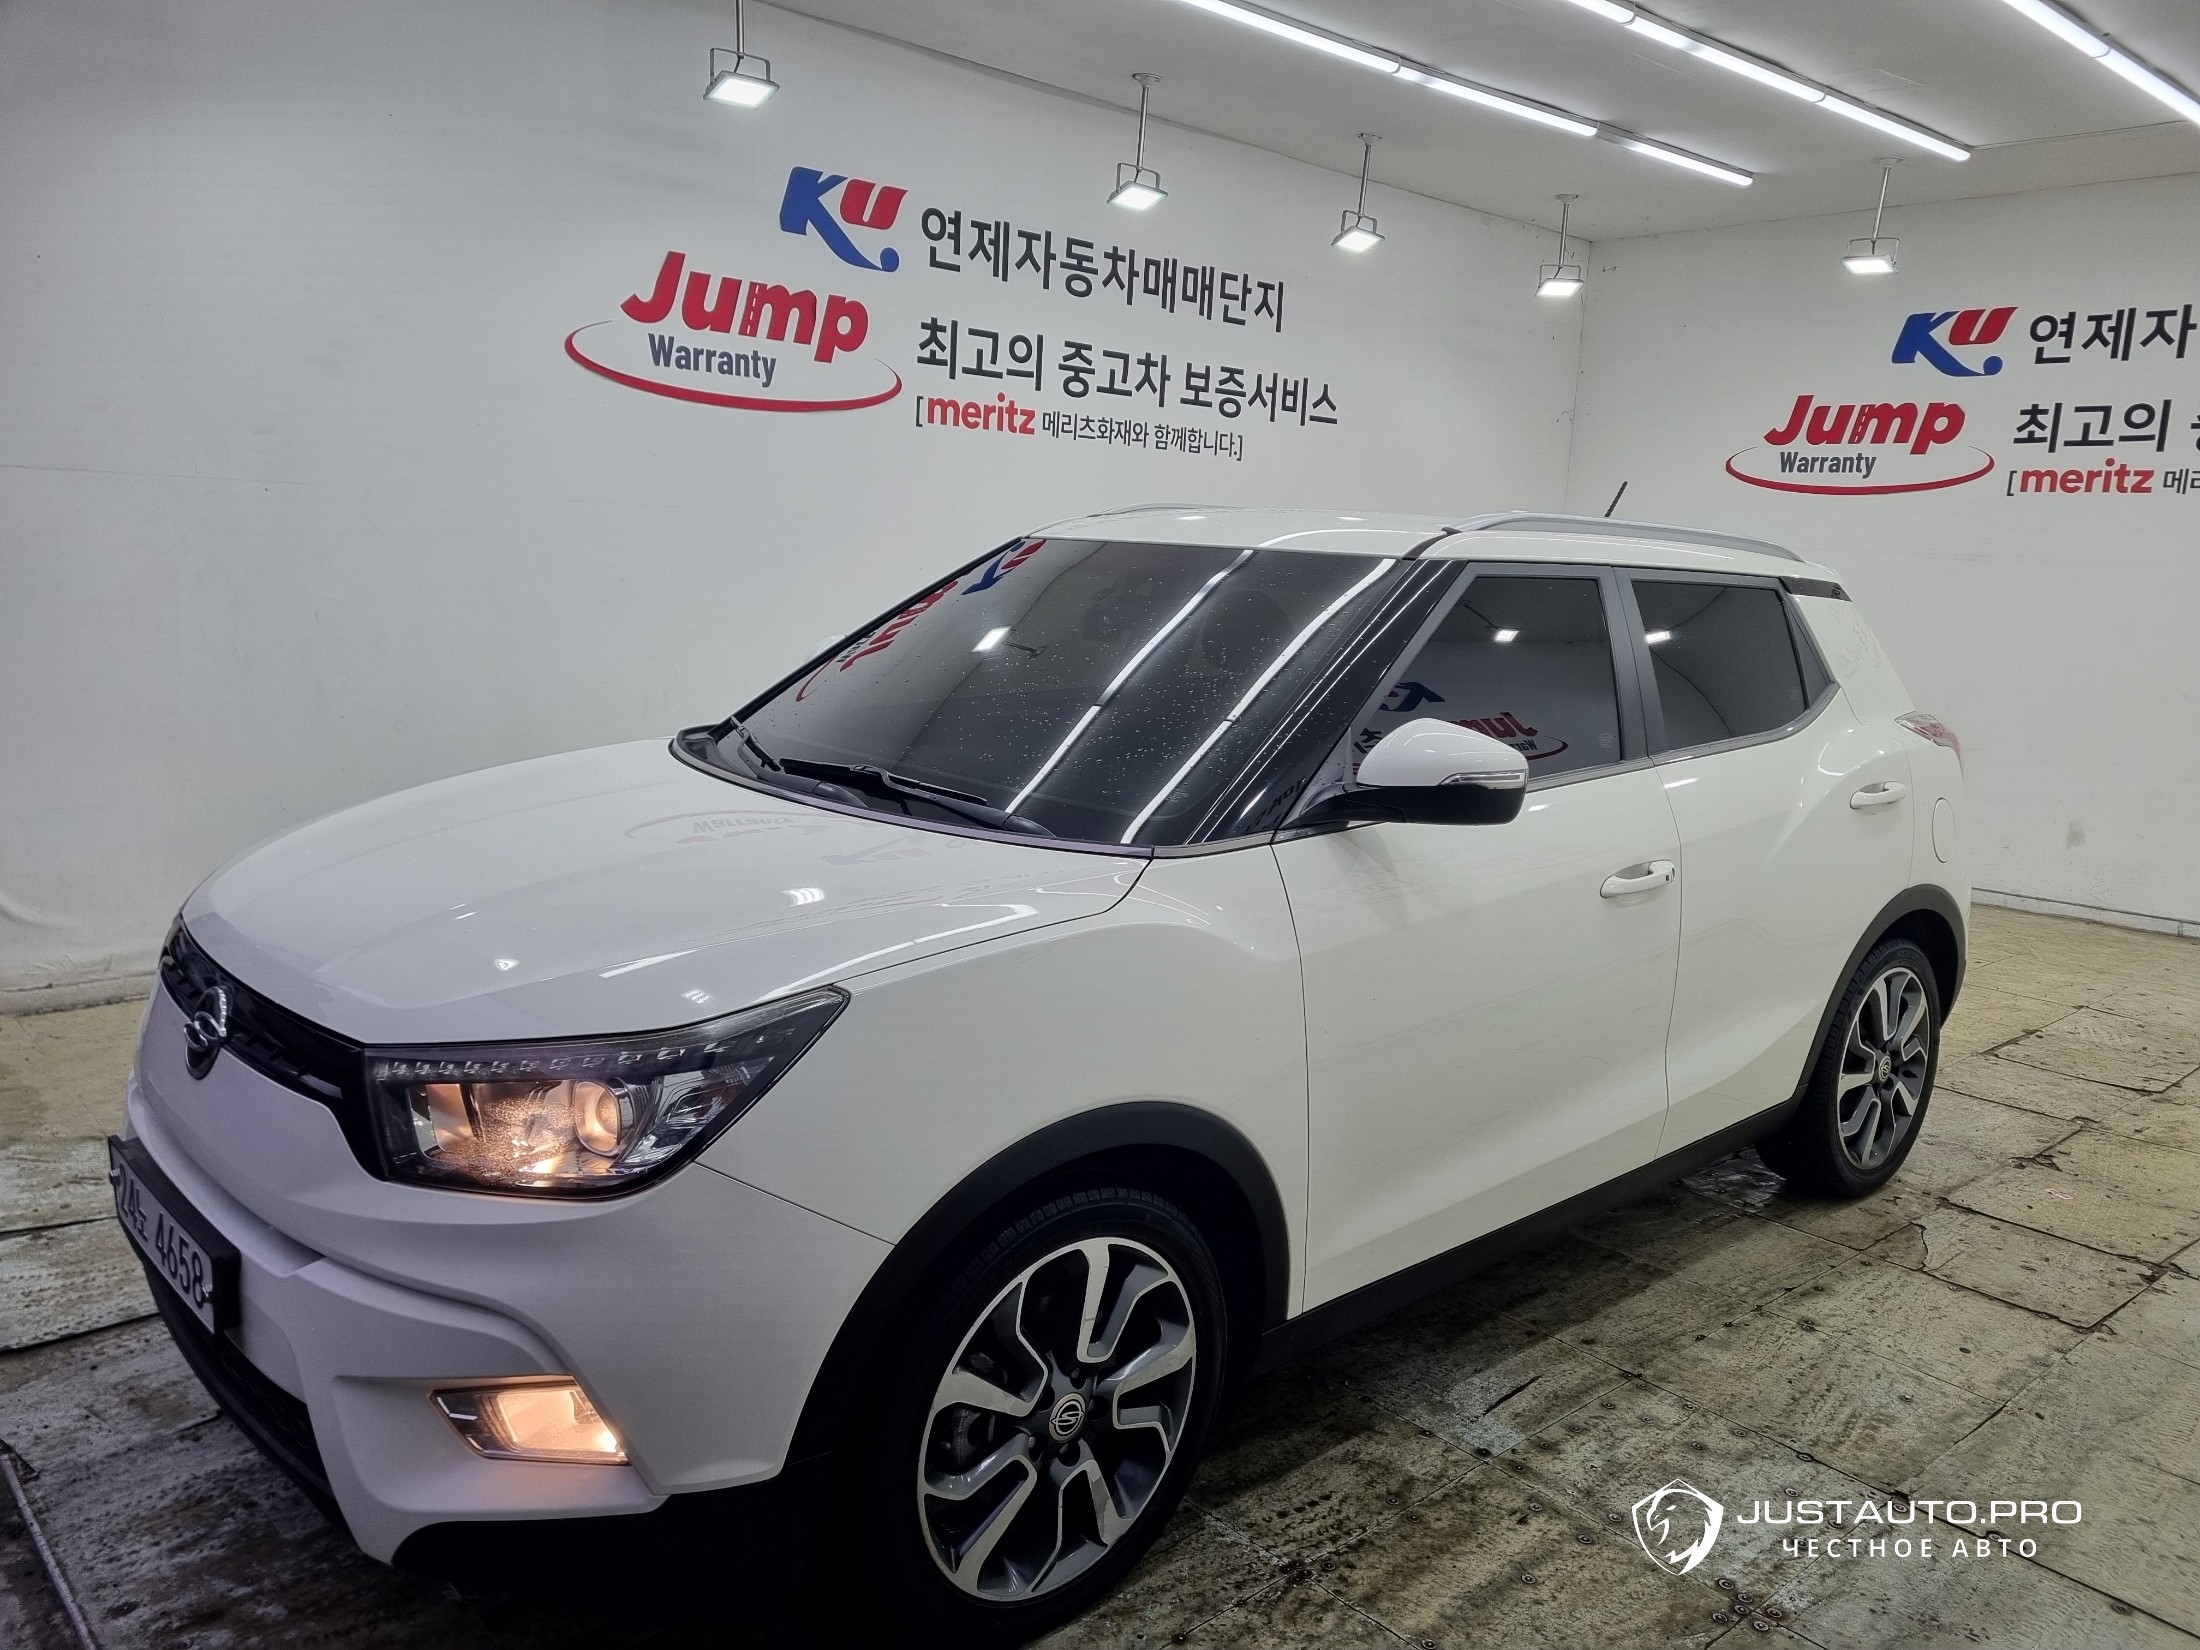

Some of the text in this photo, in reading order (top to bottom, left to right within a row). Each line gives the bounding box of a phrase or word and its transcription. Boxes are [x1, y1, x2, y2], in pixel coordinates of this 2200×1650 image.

[921, 207, 1285, 332] 연제자동차매매단지
[620, 251, 868, 363] Jump
[2029, 304, 2198, 364] 연제자
[648, 332, 776, 387] Warranty
[917, 317, 1338, 426] 최고의 중고차 보증서비스
[1042, 410, 1149, 449] 메리츠화재와
[1764, 395, 1966, 455] Jump
[2013, 399, 2172, 453] 최고의
[1780, 451, 1877, 479] Warranty
[155, 1211, 204, 1309] 4658
